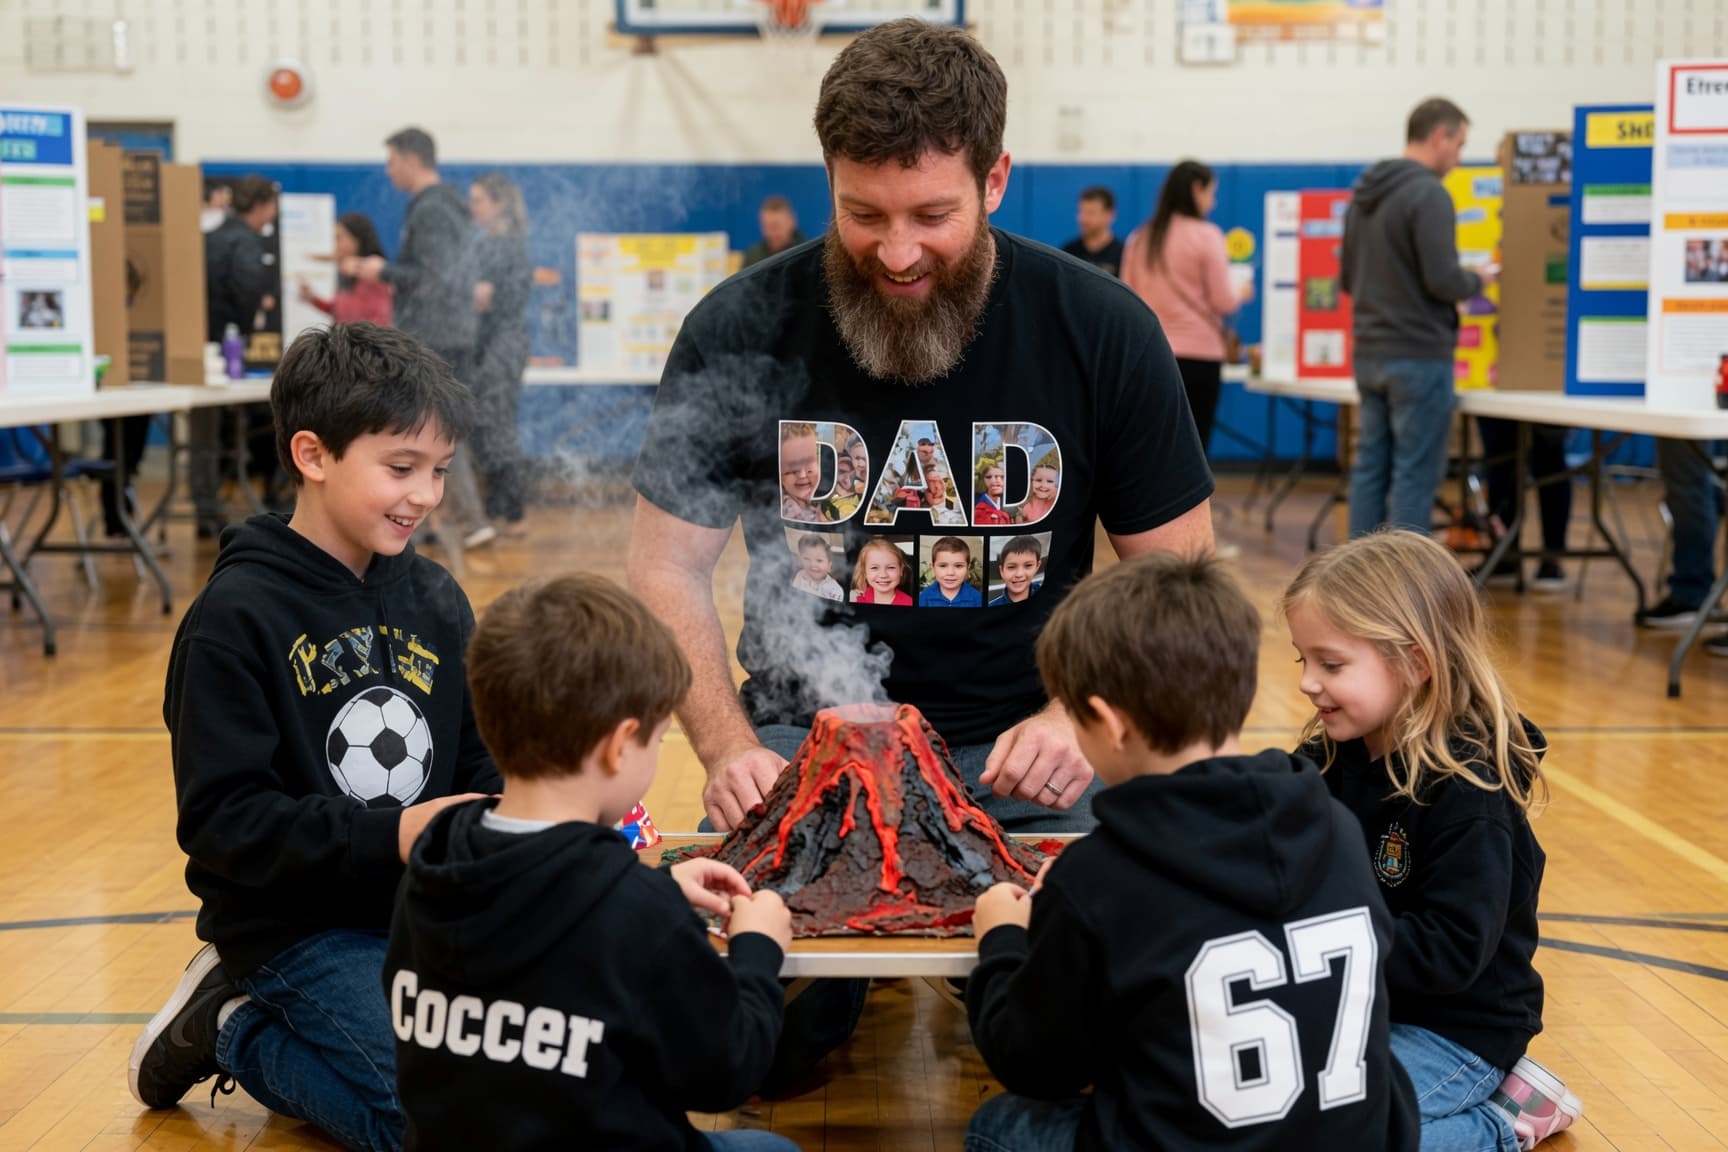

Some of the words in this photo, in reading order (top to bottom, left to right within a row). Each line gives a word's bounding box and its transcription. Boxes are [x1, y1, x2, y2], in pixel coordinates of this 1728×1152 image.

[778, 420, 1063, 527] DAD
[391, 969, 605, 1078] Coccer
[1185, 906, 1378, 1129] 67
